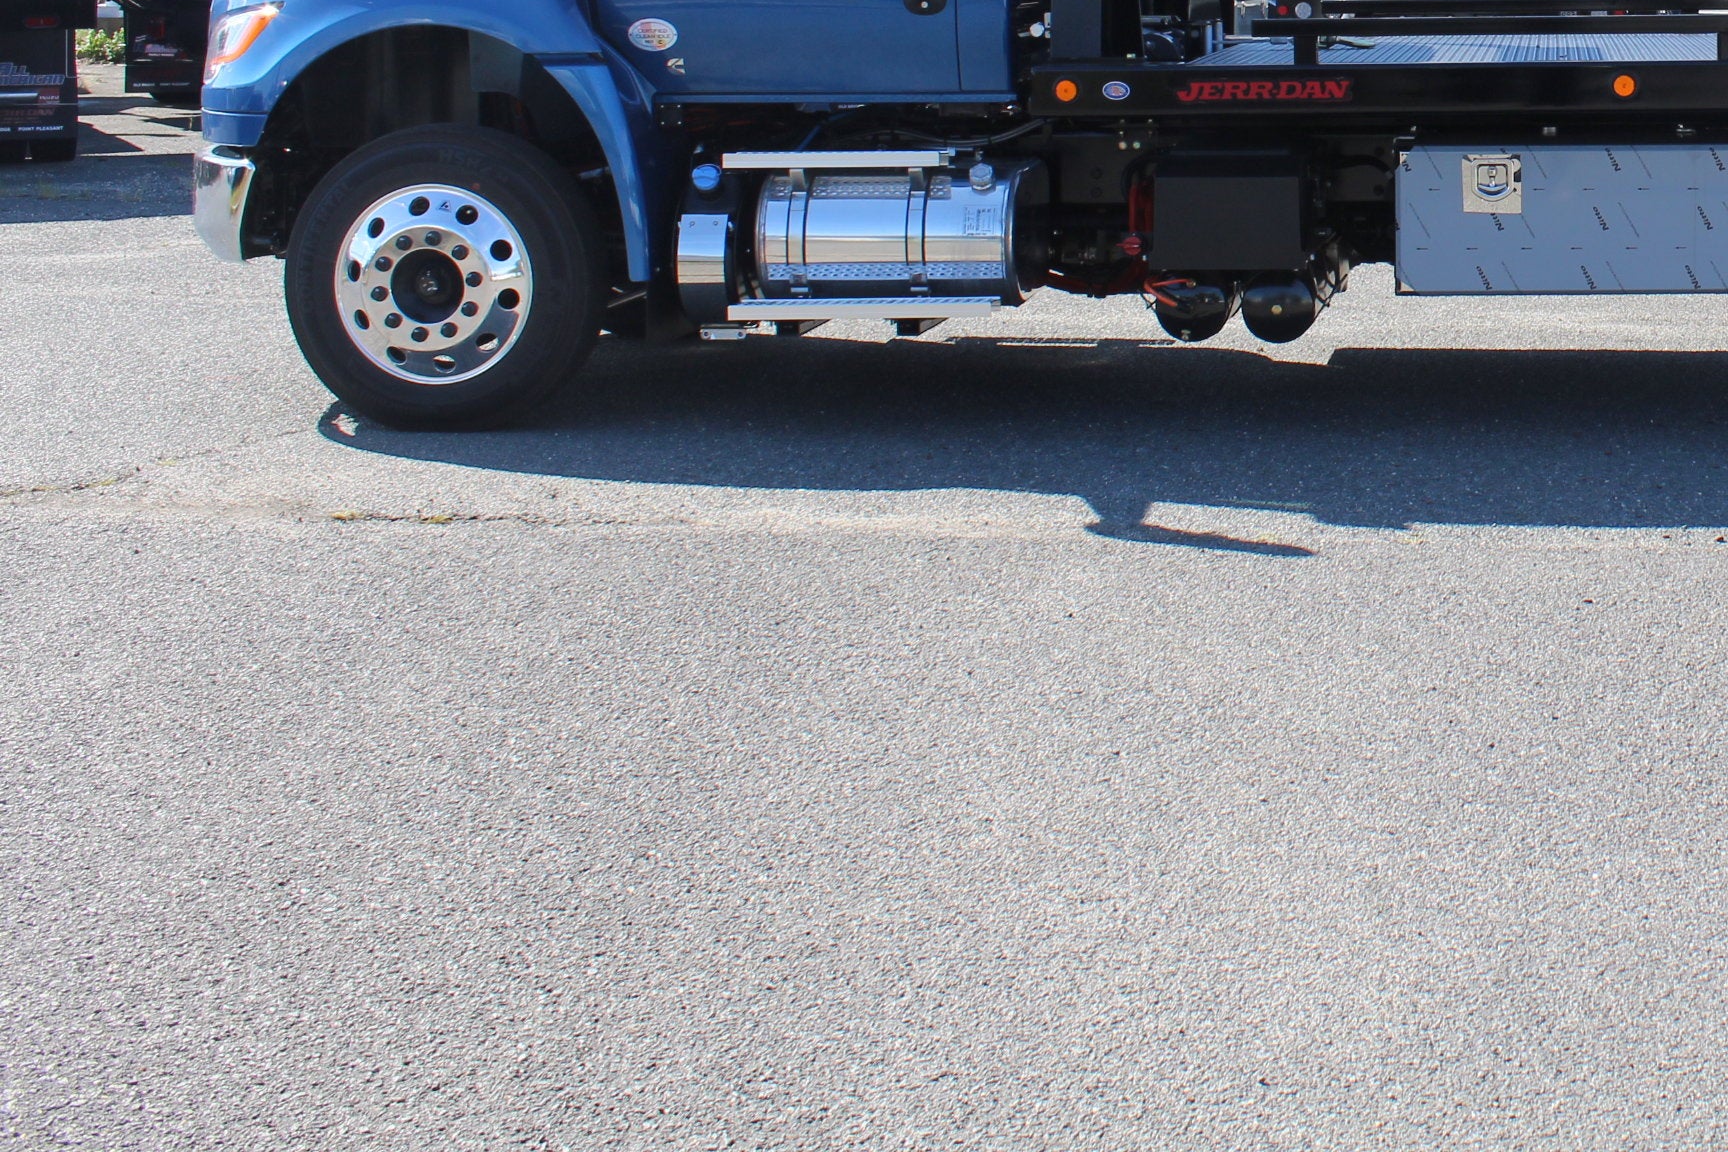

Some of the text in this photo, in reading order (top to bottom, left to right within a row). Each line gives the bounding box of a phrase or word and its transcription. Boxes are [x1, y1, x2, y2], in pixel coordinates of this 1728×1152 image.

[1176, 81, 1350, 101] JERR-DAN
[1604, 147, 1622, 173] Nitto
[1708, 147, 1726, 173] Nitto
[1592, 206, 1609, 232] Nitto
[1697, 205, 1714, 231] Nitto
[1476, 265, 1493, 291] Nitto
[1580, 264, 1597, 291] Nitto
[1684, 264, 1702, 290] Nitto
